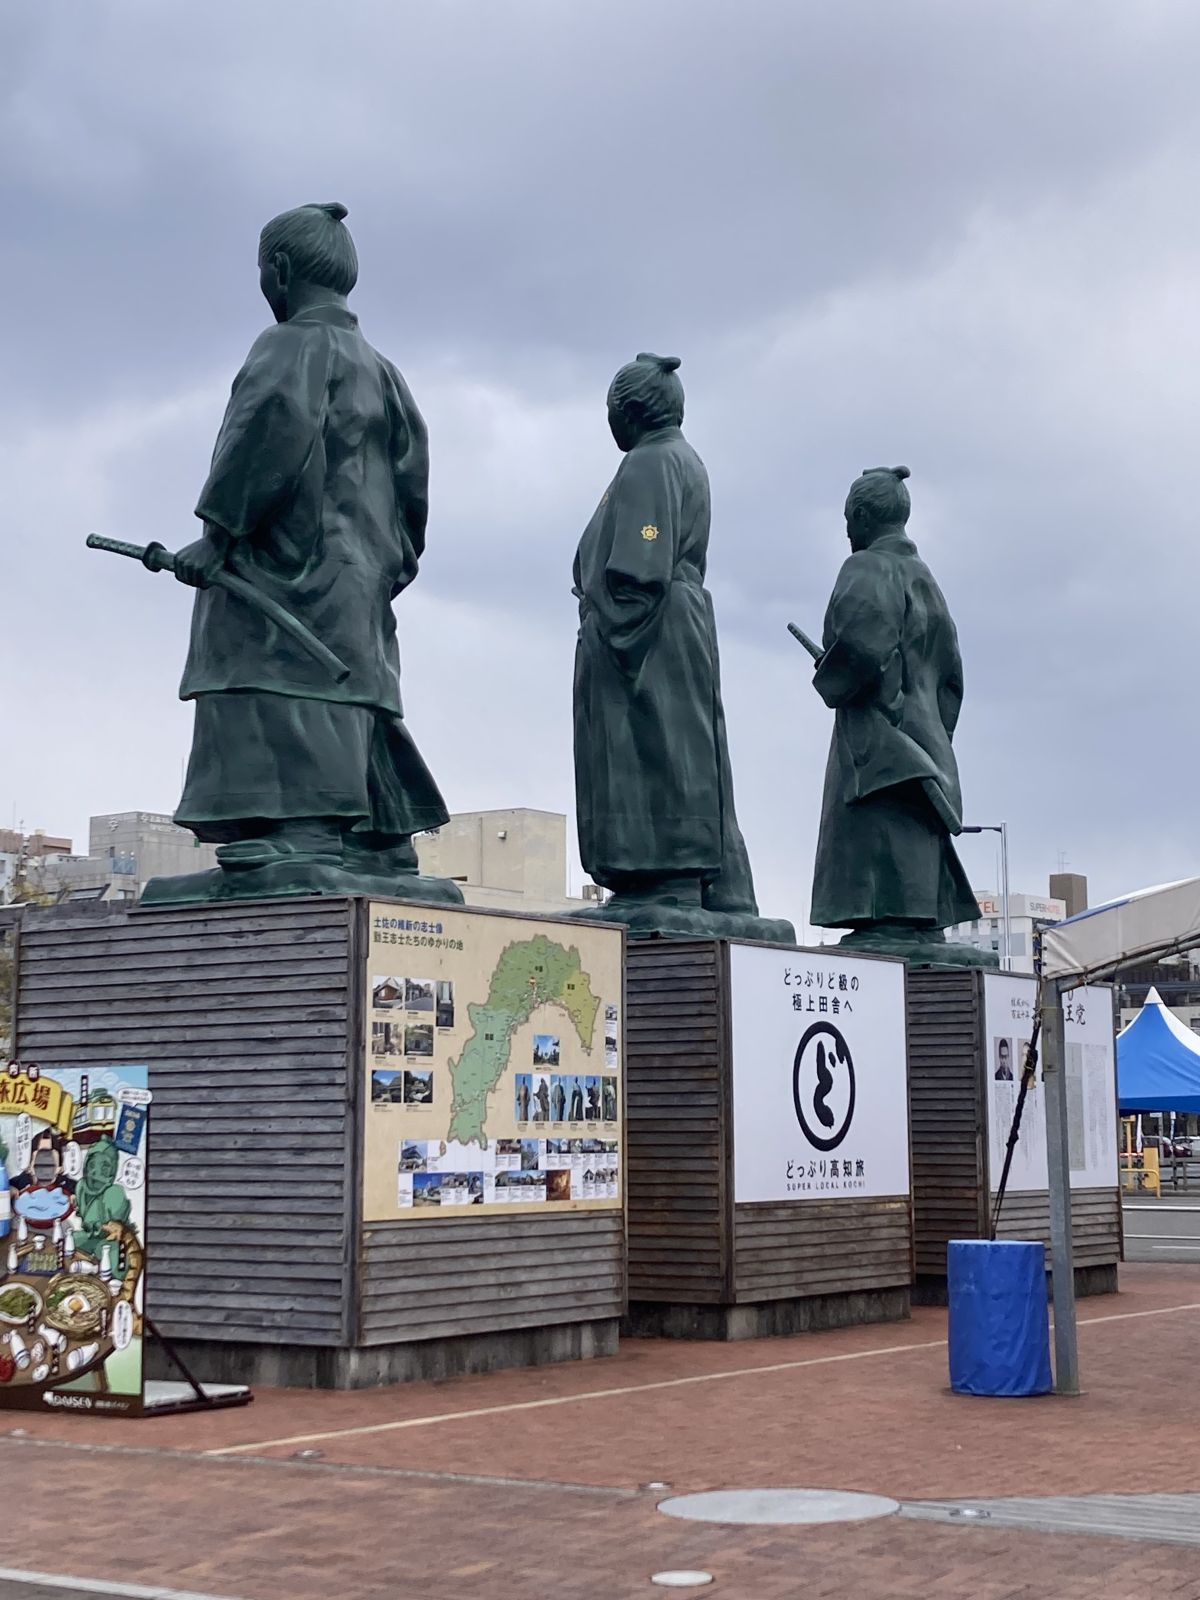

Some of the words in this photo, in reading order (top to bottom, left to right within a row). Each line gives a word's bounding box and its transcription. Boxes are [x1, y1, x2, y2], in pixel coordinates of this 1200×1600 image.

[783, 967, 860, 991] どっぷりど級の
[792, 993, 853, 1014] 極上田舎へ
[786, 1158, 865, 1179] どっぷり高知旅
[786, 1182, 811, 1191] SUPER
[815, 1181, 839, 1190] LOCAL
[843, 1180, 866, 1189] KOCHI
